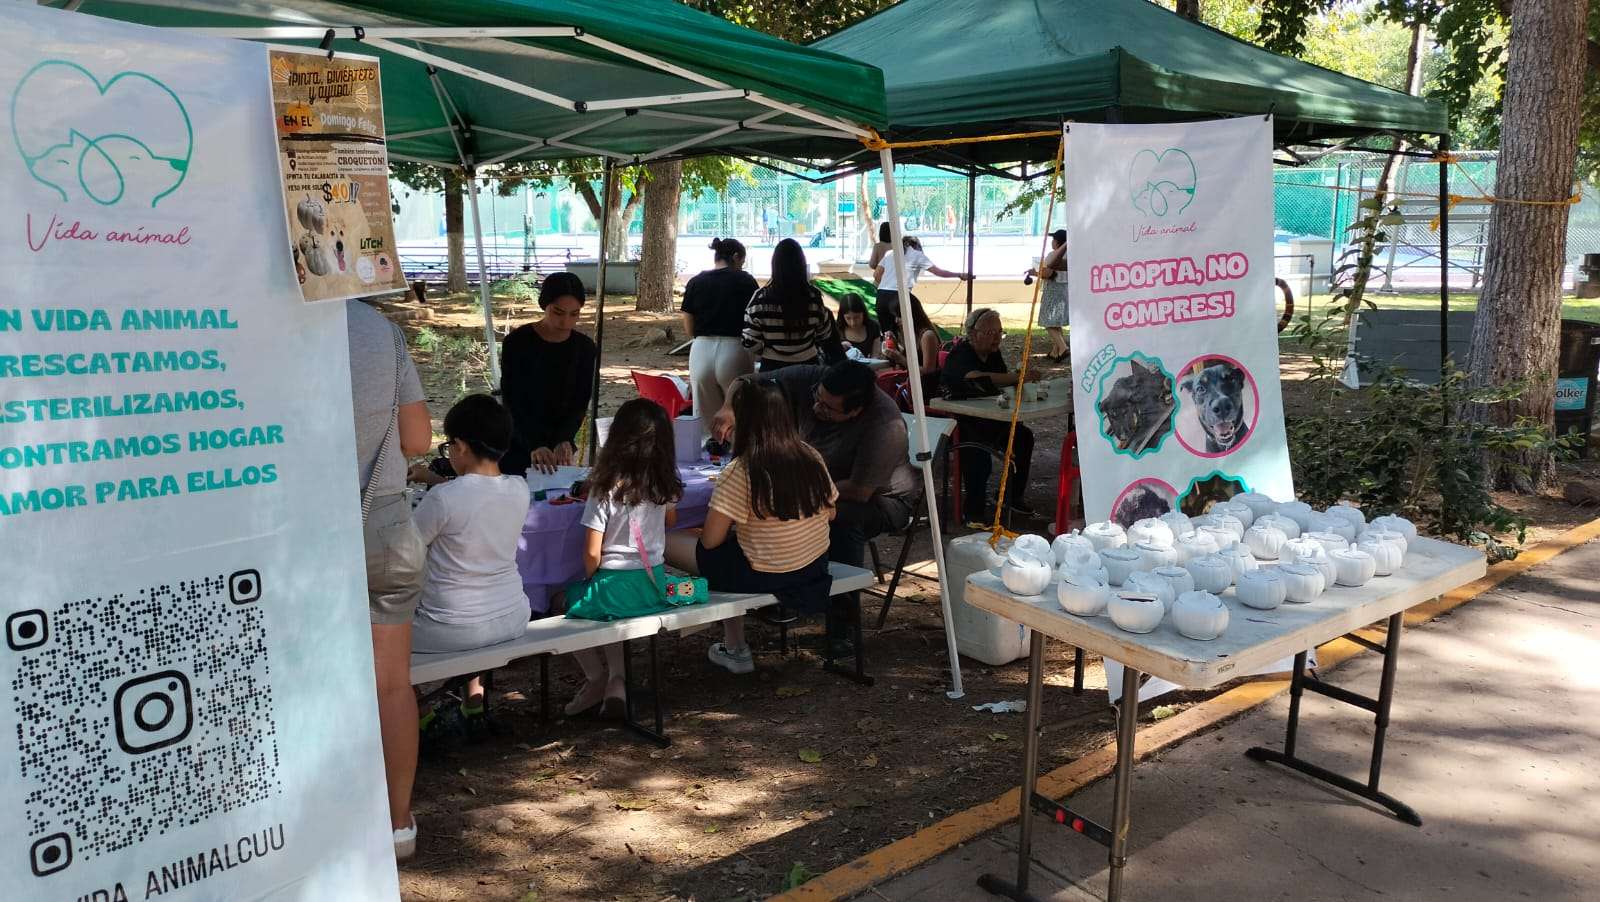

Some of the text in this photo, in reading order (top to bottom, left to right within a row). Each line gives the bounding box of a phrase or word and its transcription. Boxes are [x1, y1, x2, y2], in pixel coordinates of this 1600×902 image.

[284, 115, 313, 127] EN EL
[320, 112, 356, 129] Domingo
[27, 213, 192, 252] Vida animal
[1133, 221, 1197, 243] Vida animal
[1092, 253, 1248, 292] ¡ADOPTA, NO
[31, 309, 112, 331] VIDA
[121, 309, 238, 331] ANIMAL
[1105, 291, 1235, 330] COMPRES!
[0, 350, 226, 378] RESCATAMOS,
[1081, 344, 1116, 393] ANTES
[1555, 388, 1584, 398] olker
[189, 424, 285, 452] HOGAR
[96, 474, 180, 504] PARA
[187, 463, 278, 493] ELLOS
[145, 823, 285, 900] ANIMALCUU
